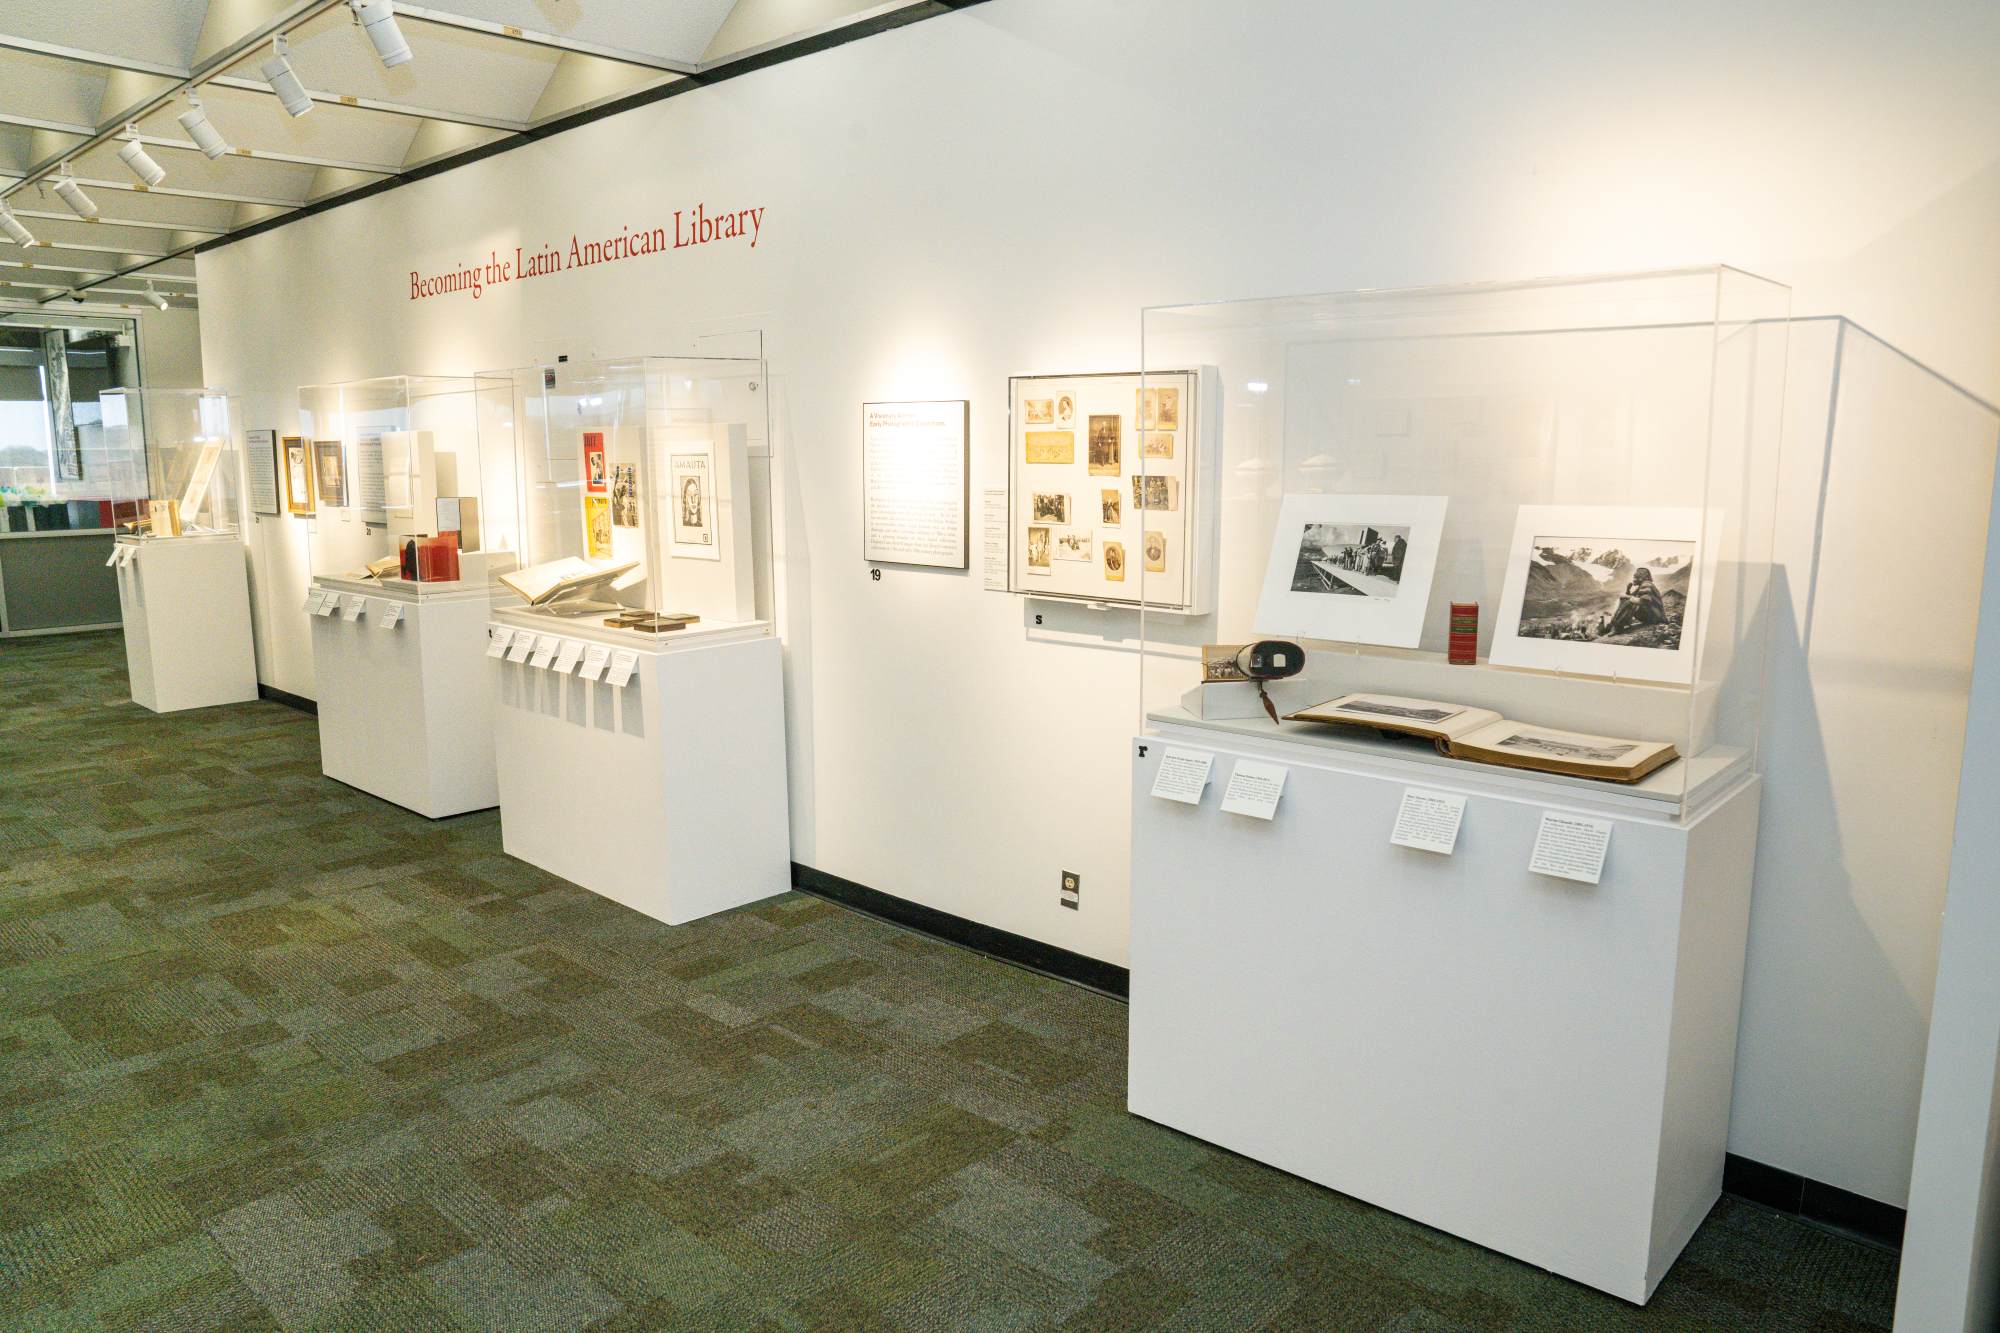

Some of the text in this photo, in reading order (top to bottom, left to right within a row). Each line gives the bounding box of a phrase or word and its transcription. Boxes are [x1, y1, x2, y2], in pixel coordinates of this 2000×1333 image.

[410, 202, 766, 300] Becoming the Latin American Library
[870, 568, 881, 582] 19
